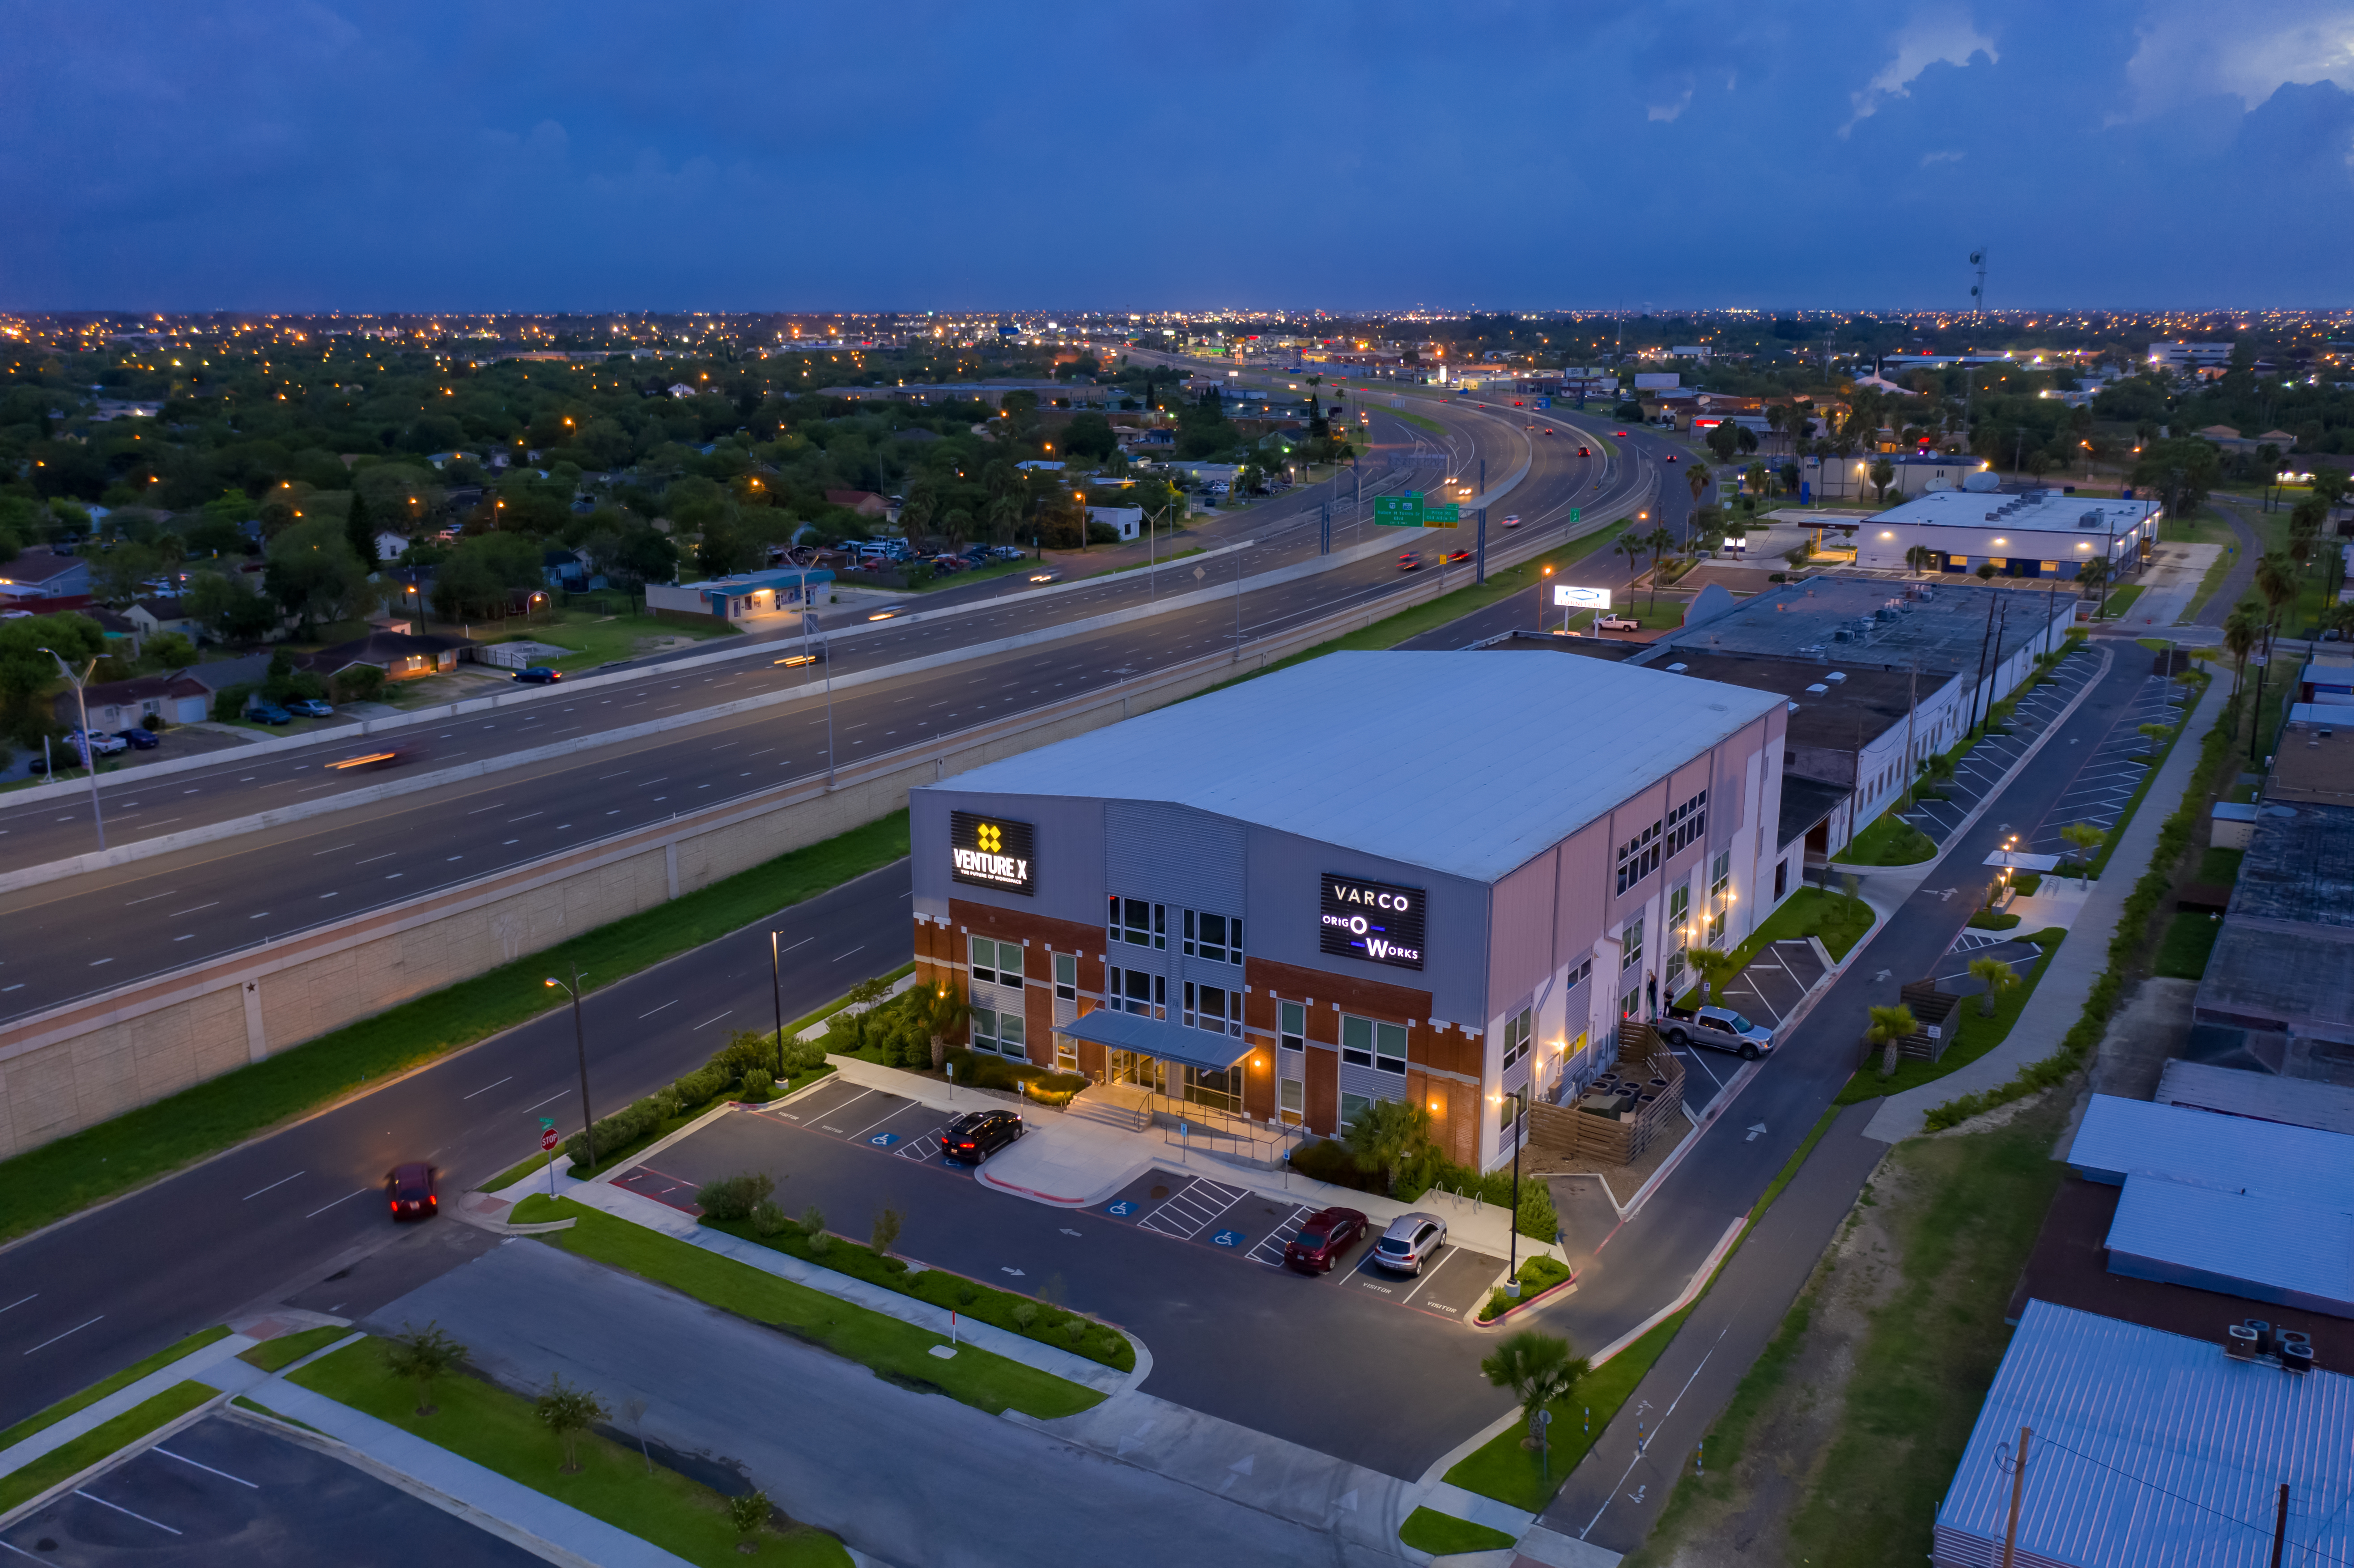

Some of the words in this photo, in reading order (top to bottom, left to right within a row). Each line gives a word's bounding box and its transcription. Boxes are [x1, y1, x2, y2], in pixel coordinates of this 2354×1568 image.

[954, 848, 1015, 878] VENTURE
[1017, 859, 1028, 880] X
[995, 875, 1022, 885] WORKSPACE
[1334, 885, 1409, 911] VARCO
[1366, 938, 1418, 959] WORKS
[778, 1112, 799, 1120] VISITOR
[822, 1125, 844, 1134] VISITOR
[542, 1133, 557, 1146] STOP
[1363, 1282, 1392, 1294] VISITOR
[1428, 1301, 1457, 1313] VISITOR
